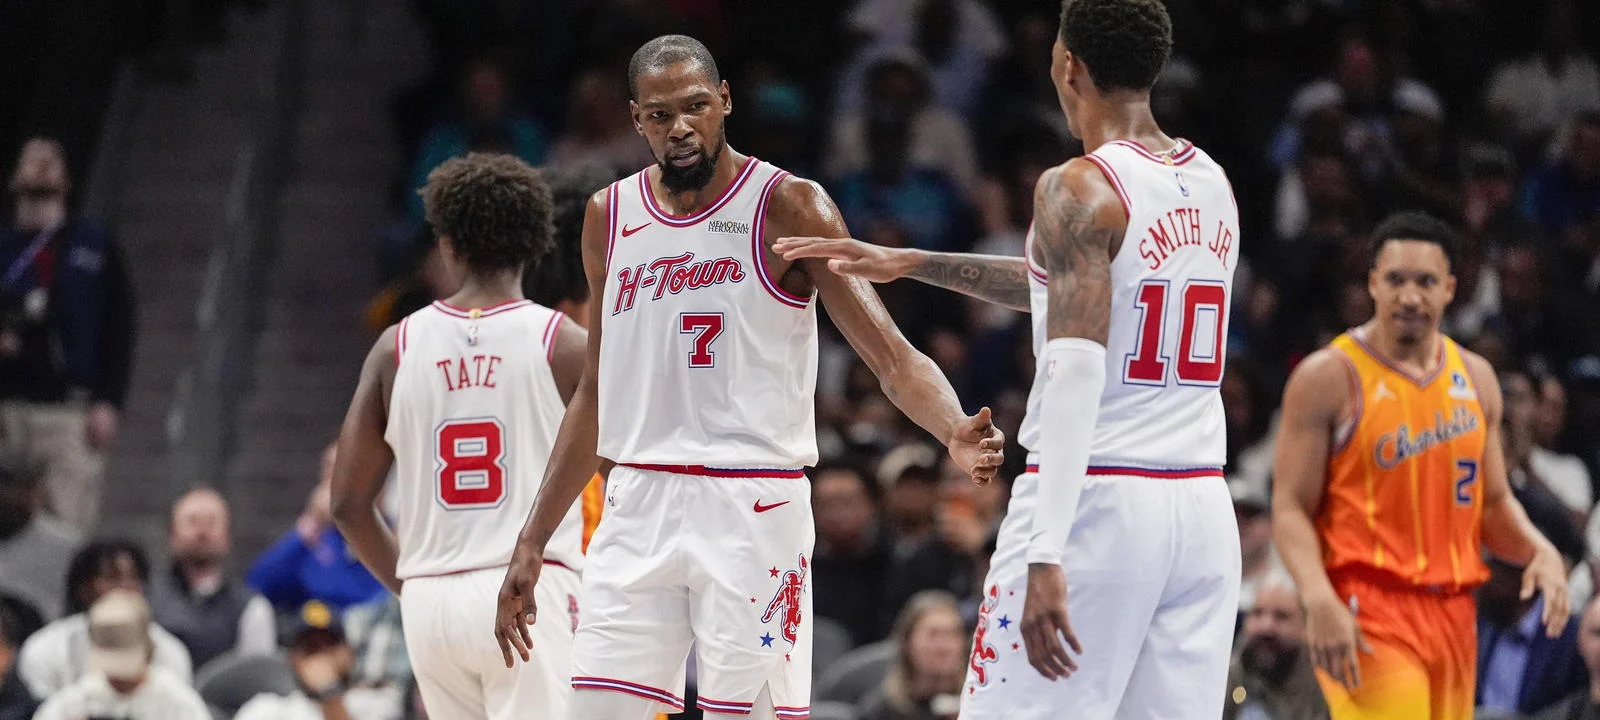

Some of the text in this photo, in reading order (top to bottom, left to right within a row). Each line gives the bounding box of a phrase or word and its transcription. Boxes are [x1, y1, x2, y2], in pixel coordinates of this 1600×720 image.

[708, 226, 749, 234] HERMANN
[709, 220, 749, 229] MEMORIAL
[1139, 208, 1201, 270] SMITH
[612, 252, 746, 316] H-Town
[680, 312, 724, 368] 7
[1123, 279, 1228, 387] 10
[436, 355, 502, 392] TATE
[434, 416, 508, 512] 8
[1455, 458, 1478, 504] 2
